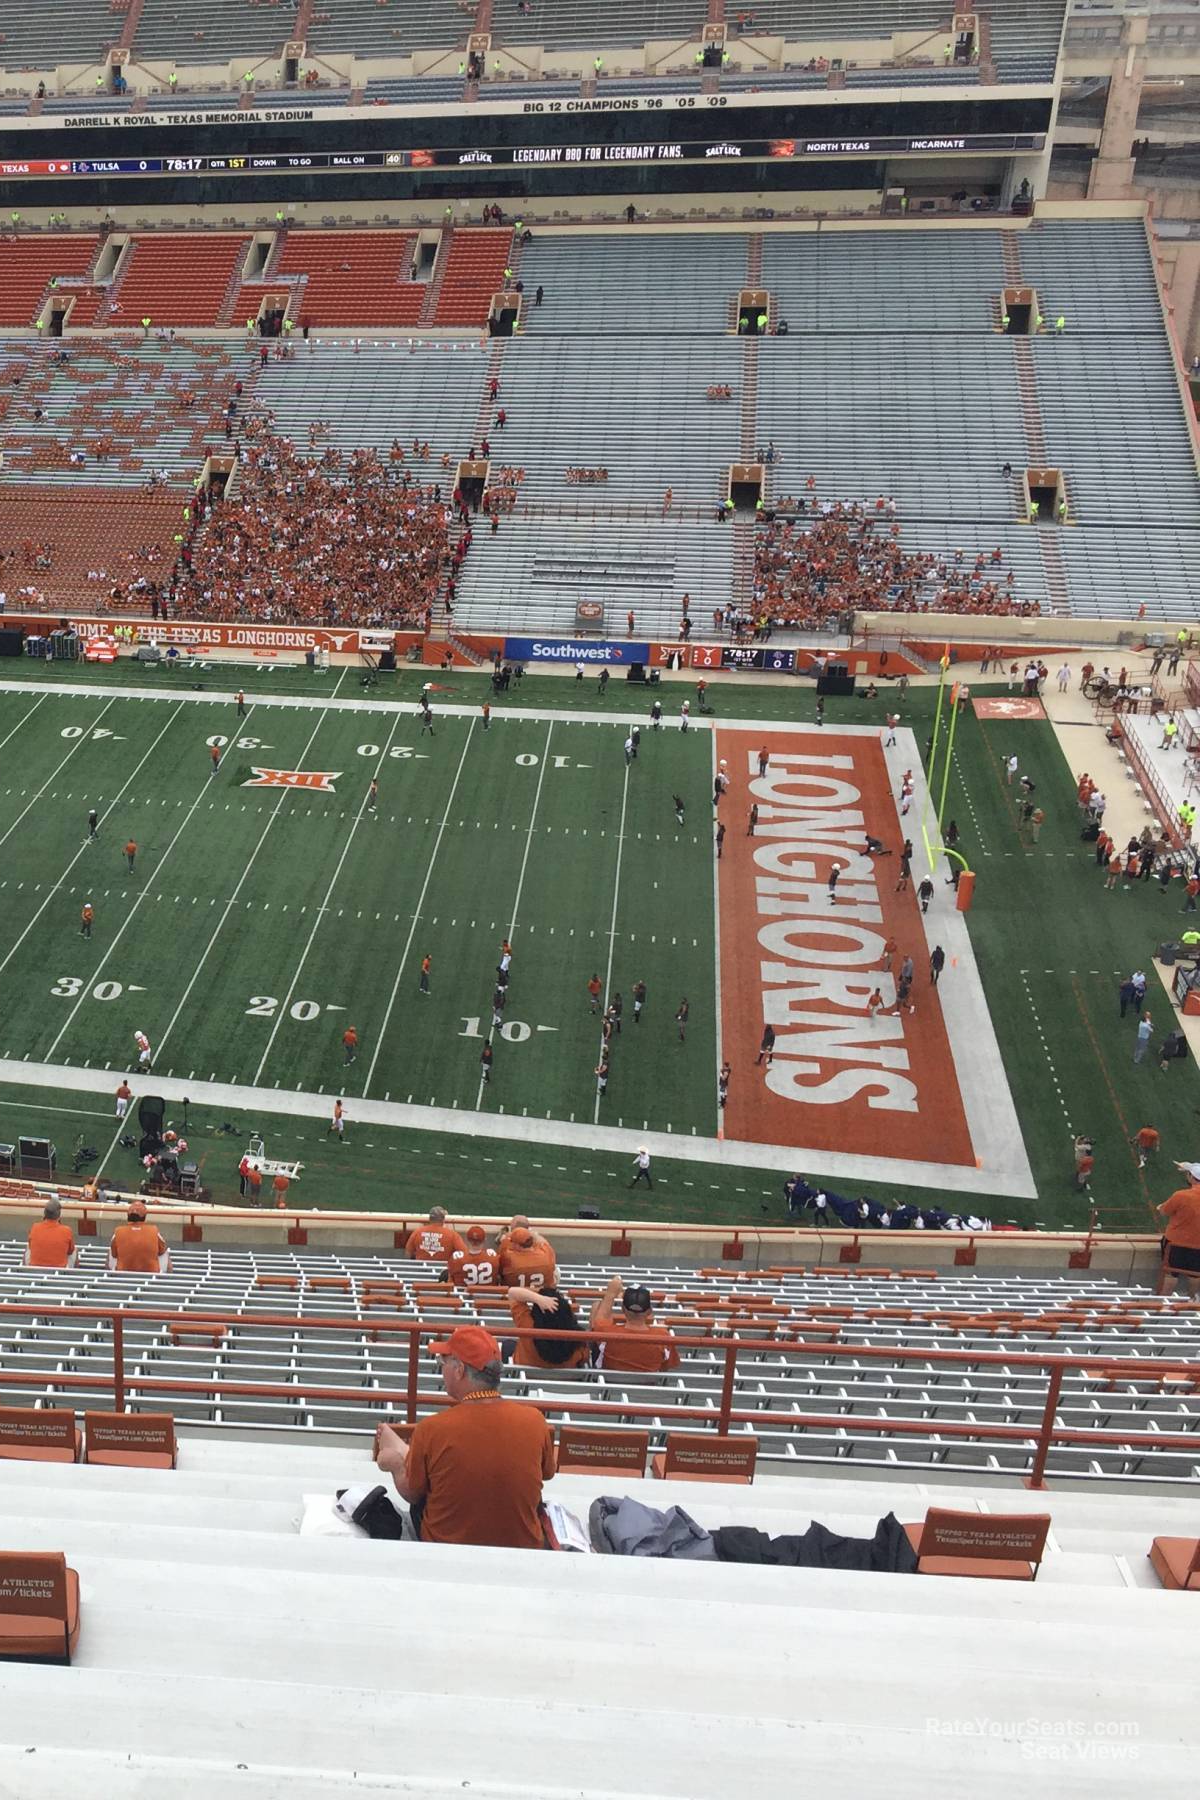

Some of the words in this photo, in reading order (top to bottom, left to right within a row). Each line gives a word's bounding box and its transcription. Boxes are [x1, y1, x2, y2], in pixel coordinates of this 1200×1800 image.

[523, 102, 544, 113] BIG
[549, 101, 562, 112] 12
[566, 99, 640, 112] CHAMPIONS
[643, 98, 664, 109] '96
[675, 97, 696, 108] '05
[706, 96, 728, 107] '09
[64, 115, 112, 128] DARRELL
[113, 114, 122, 126] K
[124, 113, 158, 126] ROYAL
[167, 113, 204, 125] TEXAS
[205, 111, 263, 124] MEMORIAL
[265, 110, 314, 122] STADIUM
[806, 142, 840, 151] NORTH
[840, 141, 870, 150] TEXAS
[911, 139, 966, 149] INCARNATE
[333, 157, 350, 165] BALL
[351, 156, 366, 165] ON
[386, 153, 400, 164] 40
[512, 148, 562, 163] LEGENDARY
[565, 148, 583, 162] BBQ
[584, 146, 601, 160] FOR
[604, 145, 655, 160] LEGENDARY
[658, 144, 685, 159] FANS.
[1, 163, 30, 173] TEXAS
[48, 163, 56, 173] 0
[92, 161, 120, 171] TULSA
[139, 160, 147, 171] 0
[166, 159, 202, 171] 78:17
[228, 159, 246, 169] 1ST
[253, 158, 277, 167] DOWN
[288, 158, 299, 166] TO
[300, 157, 312, 166] GO
[136, 626, 167, 642] THE
[171, 627, 222, 644] TEXAS
[226, 630, 316, 648] LONGHORNS
[532, 643, 612, 660] Southwest
[729, 649, 759, 658] 78:17
[703, 657, 712, 665] 0
[773, 660, 782, 668] 0
[59, 726, 115, 741] 40
[205, 734, 263, 750] 30
[356, 743, 416, 759] 20
[514, 752, 573, 769] 10
[747, 750, 920, 1113] LONGHORNS
[50, 976, 123, 1001] 30
[244, 996, 321, 1021] 20
[457, 1016, 532, 1042] 10
[462, 1261, 494, 1285] 32
[517, 1272, 546, 1292] 12
[2, 1578, 56, 1589] ATHLETICS
